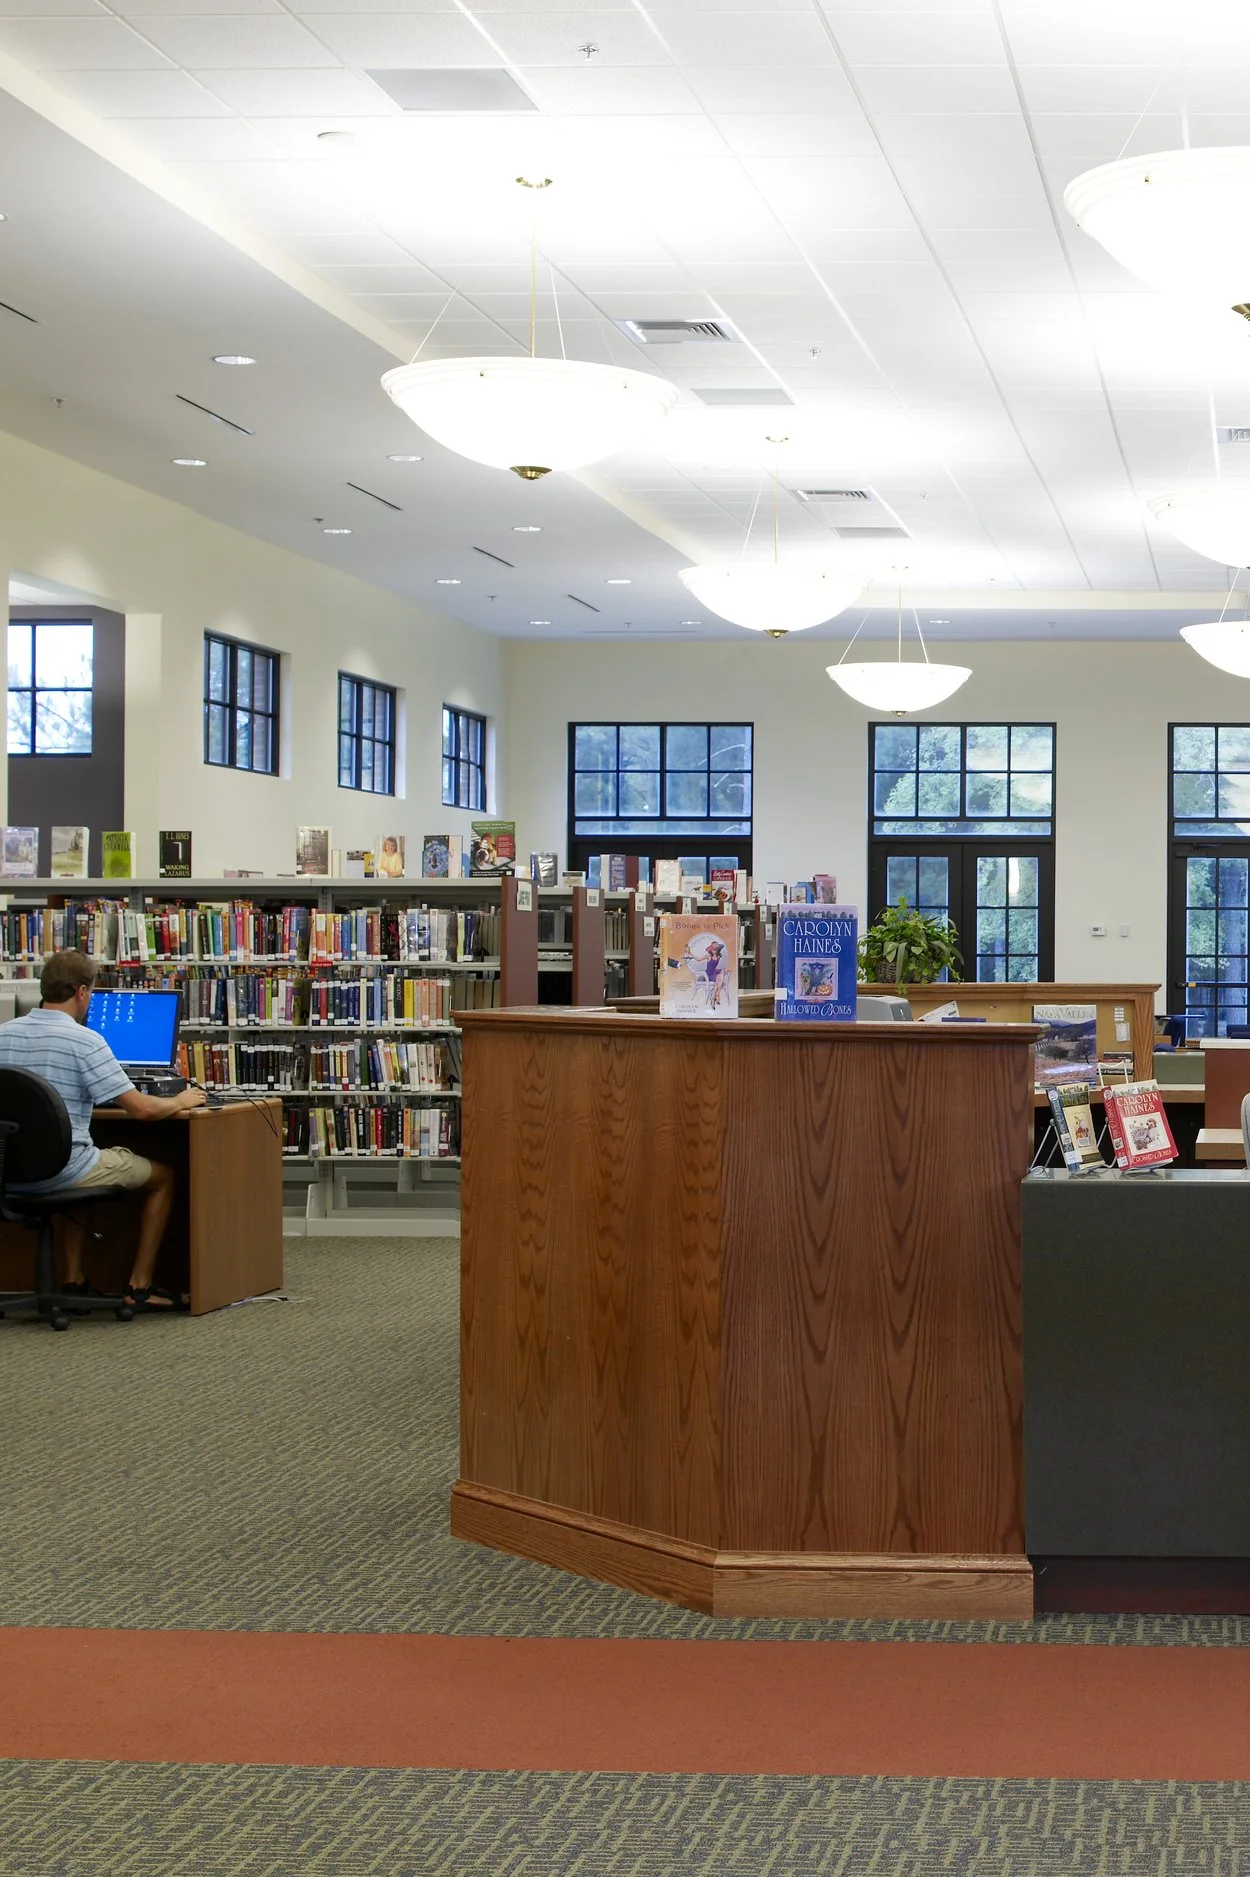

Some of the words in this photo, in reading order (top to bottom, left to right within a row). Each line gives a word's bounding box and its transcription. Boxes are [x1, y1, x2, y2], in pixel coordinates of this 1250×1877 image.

[783, 920, 852, 937] CAROLYN
[794, 938, 842, 954] HAINES
[780, 1002, 820, 1015] HALLOWED
[820, 1003, 852, 1017] BONES
[1036, 1010, 1060, 1019] NAPA
[1116, 1092, 1159, 1107] CAROLYN
[1123, 1102, 1155, 1115] HAINES
